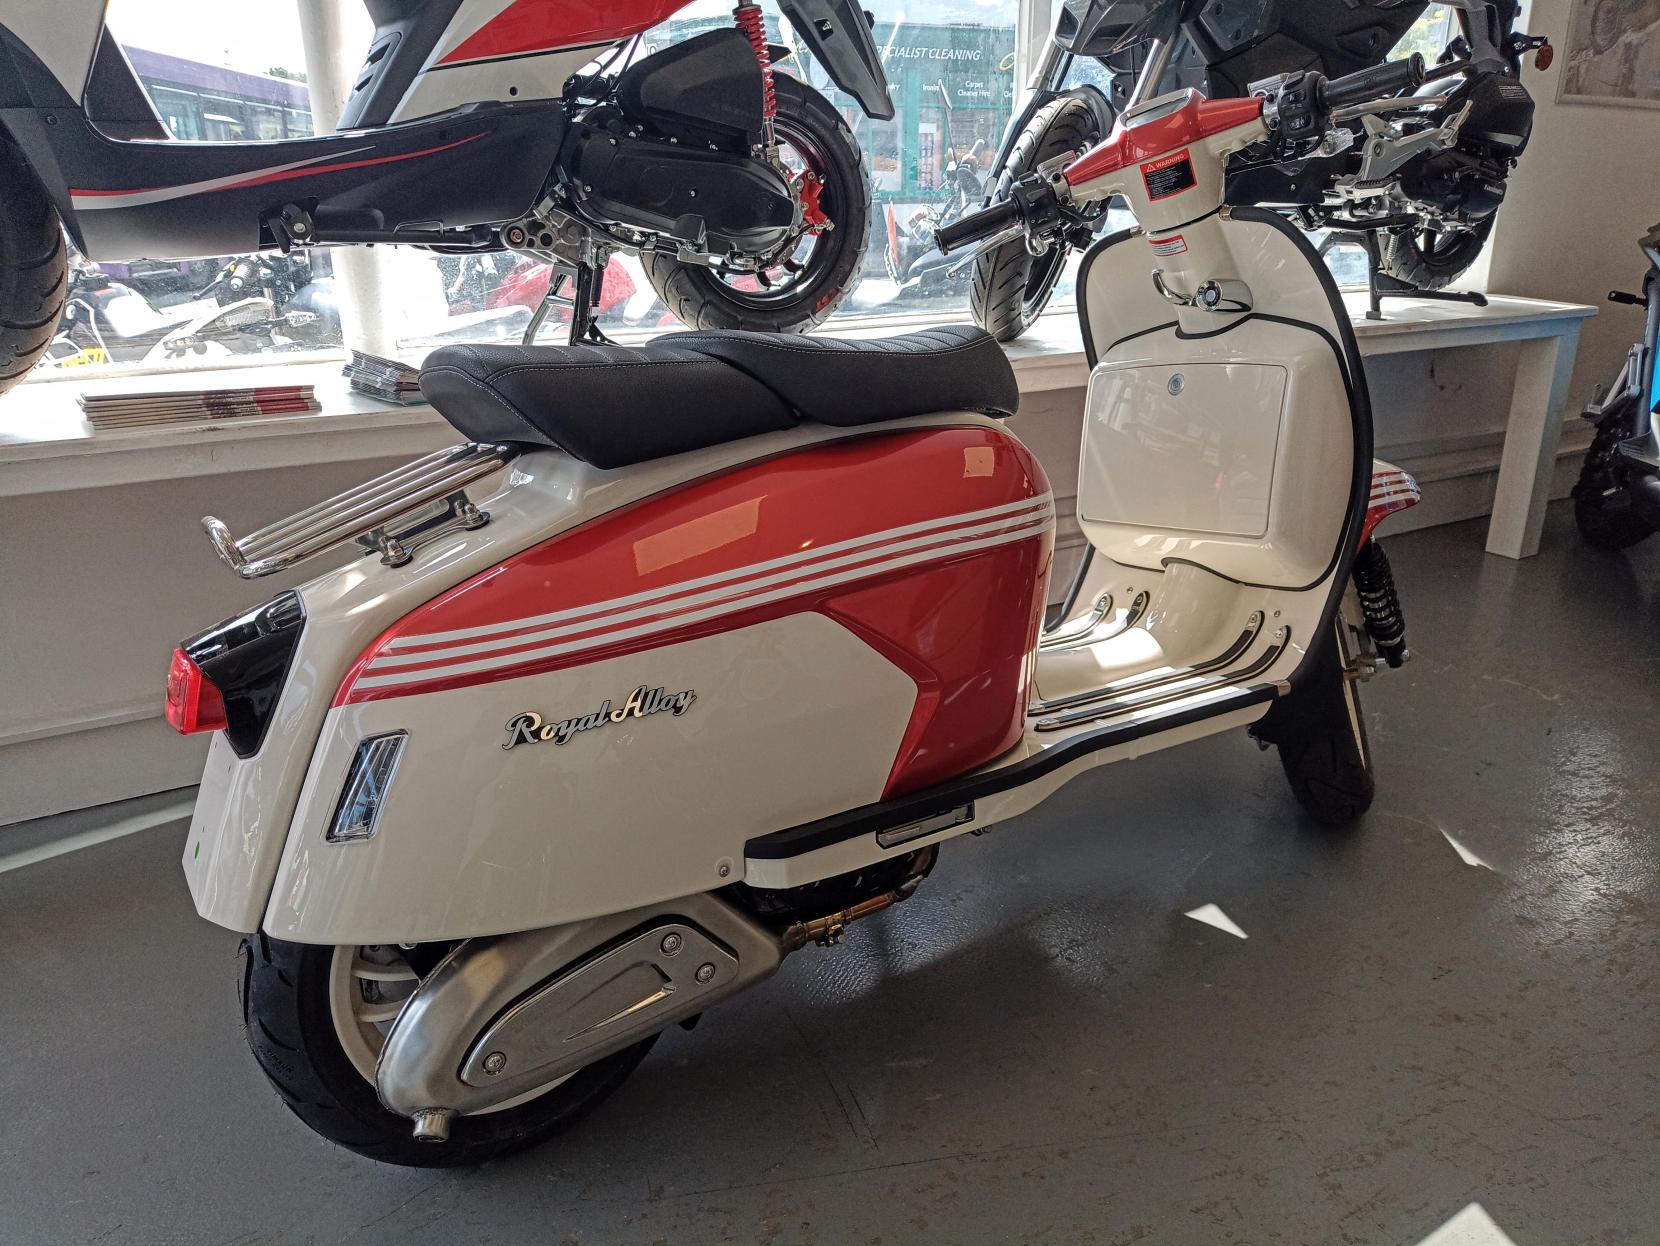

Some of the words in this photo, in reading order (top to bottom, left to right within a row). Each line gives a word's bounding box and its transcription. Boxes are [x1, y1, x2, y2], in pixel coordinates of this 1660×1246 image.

[876, 46, 927, 59] PECIALIST
[928, 48, 981, 60] CLEANING
[965, 80, 984, 90] Carpet
[1155, 153, 1185, 168] WARNING
[502, 700, 611, 751] Royal
[610, 684, 698, 723] Alloy
